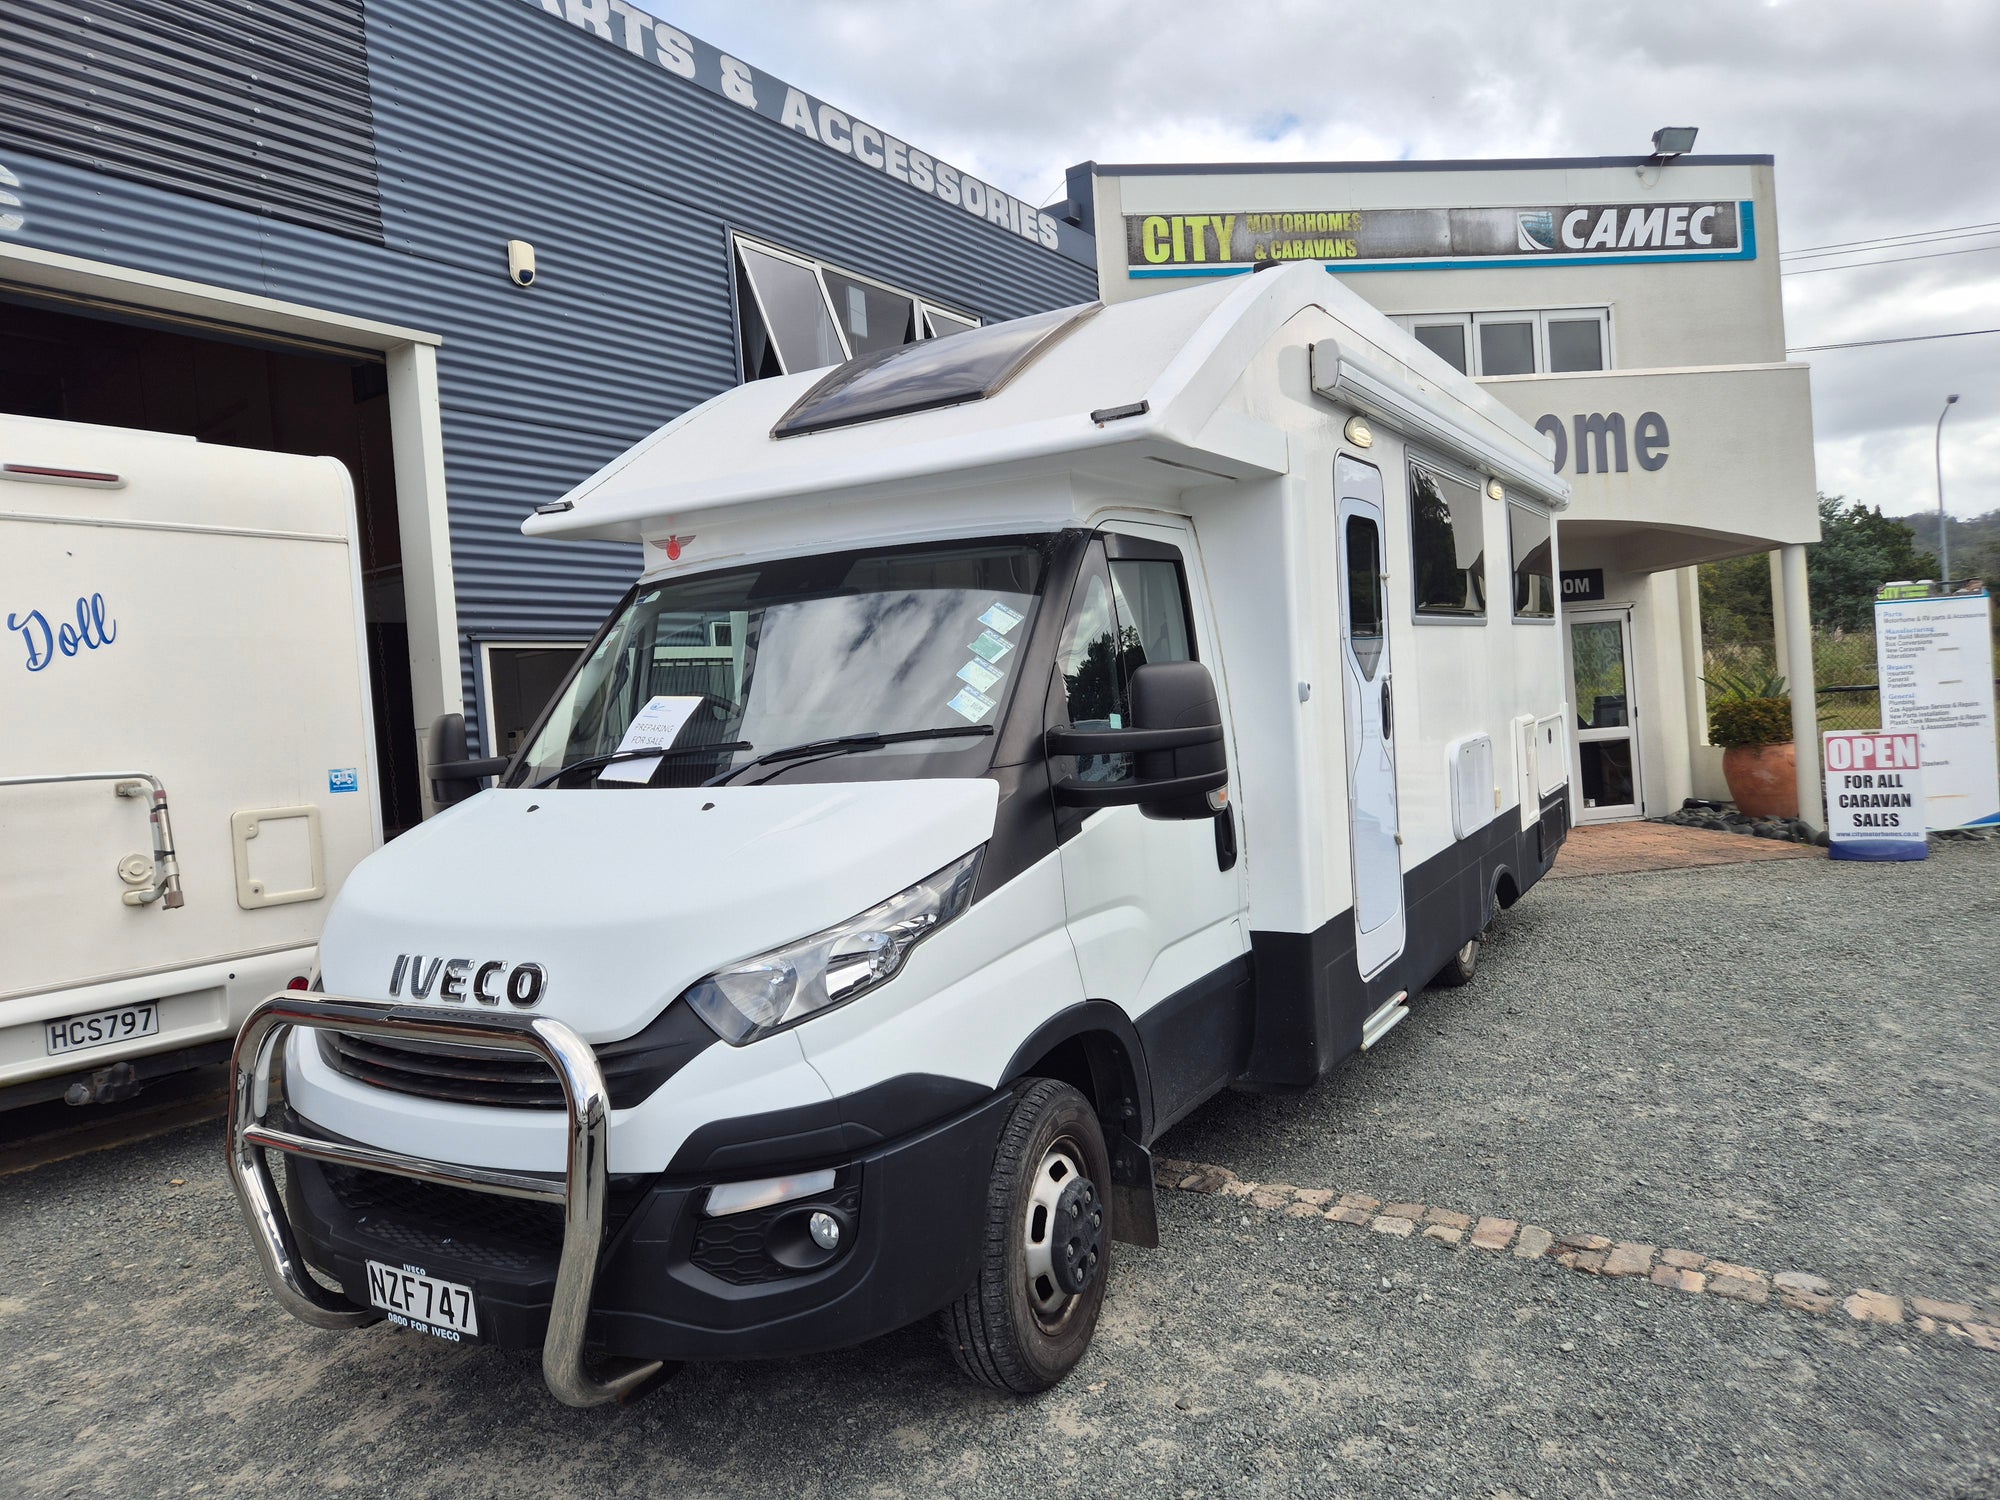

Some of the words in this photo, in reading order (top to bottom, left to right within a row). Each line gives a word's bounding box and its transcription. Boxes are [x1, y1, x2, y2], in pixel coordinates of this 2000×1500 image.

[719, 54, 758, 110] &
[780, 86, 1059, 250] ACCESSORIES
[1246, 212, 1362, 233] MOTORHOMES
[1561, 206, 1716, 249] CAMEC
[1142, 215, 1237, 263] CITY
[1254, 243, 1267, 260] &
[1271, 238, 1358, 259] CARAVANS
[1560, 577, 1590, 594] OM
[7, 592, 116, 671] Doll
[631, 735, 646, 744] FOR
[646, 737, 664, 745] SALE
[635, 723, 674, 733] PREPARING
[1828, 736, 1917, 770] OPEN
[1844, 775, 1873, 788] FOR
[1877, 774, 1903, 788] ALL
[1838, 793, 1912, 808] CARAVAN
[1852, 812, 1900, 828] SALES
[388, 954, 549, 1009] IVECO
[51, 1007, 152, 1049] HCS797
[403, 1264, 426, 1276] IVECO
[369, 1264, 470, 1328] NZF747
[388, 1312, 408, 1327] 0800
[411, 1320, 428, 1333] FOR
[431, 1326, 460, 1342] IVECO
